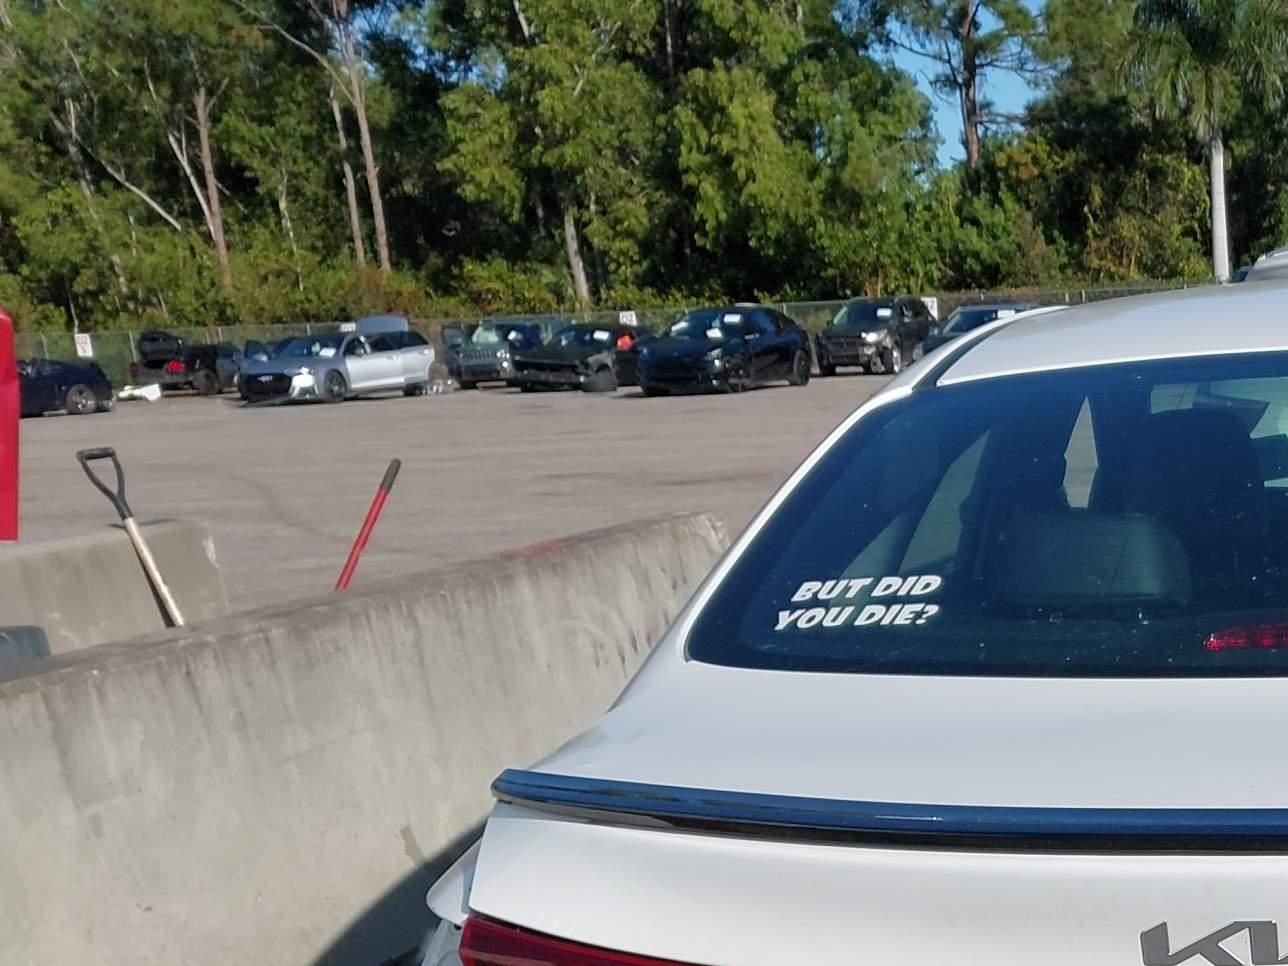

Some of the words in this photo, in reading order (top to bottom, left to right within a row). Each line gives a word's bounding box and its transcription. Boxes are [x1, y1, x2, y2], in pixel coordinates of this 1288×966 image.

[790, 577, 874, 602] BUT
[871, 575, 942, 597] DID
[774, 605, 856, 631] YOU
[853, 603, 940, 626] DIE?
